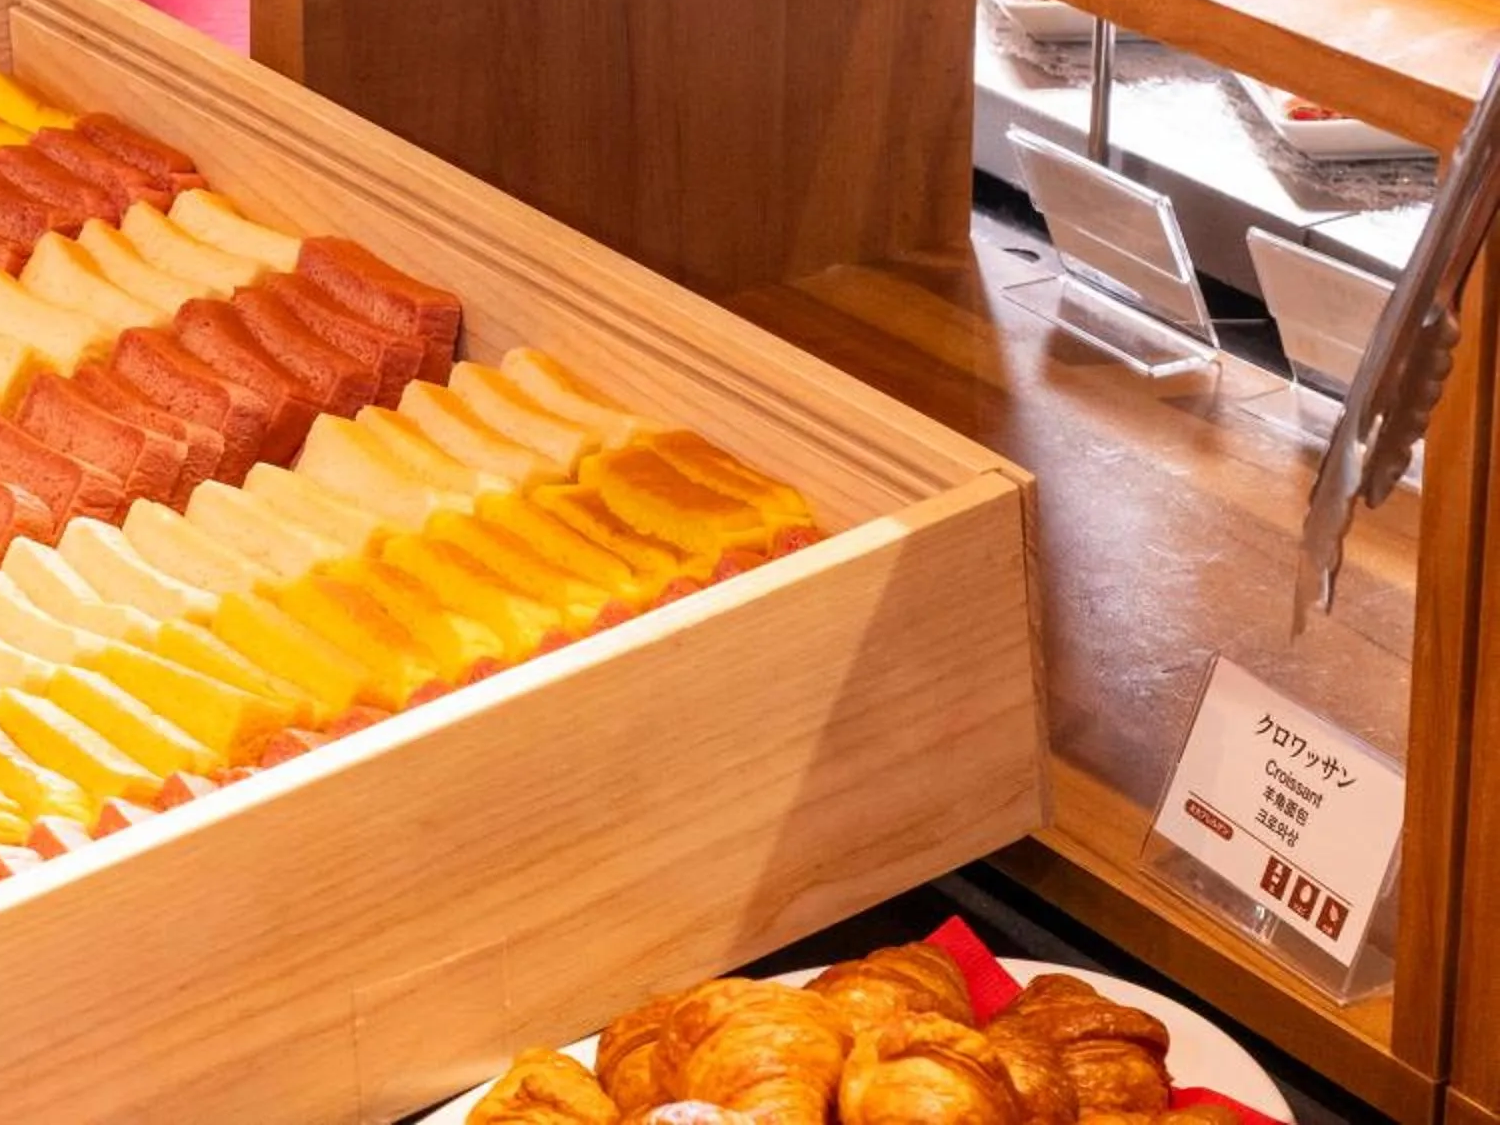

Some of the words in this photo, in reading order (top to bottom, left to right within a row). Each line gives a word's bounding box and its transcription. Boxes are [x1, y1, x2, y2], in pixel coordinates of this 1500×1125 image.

[1255, 714, 1357, 787] クロワッサン
[1265, 759, 1323, 808] Croissant
